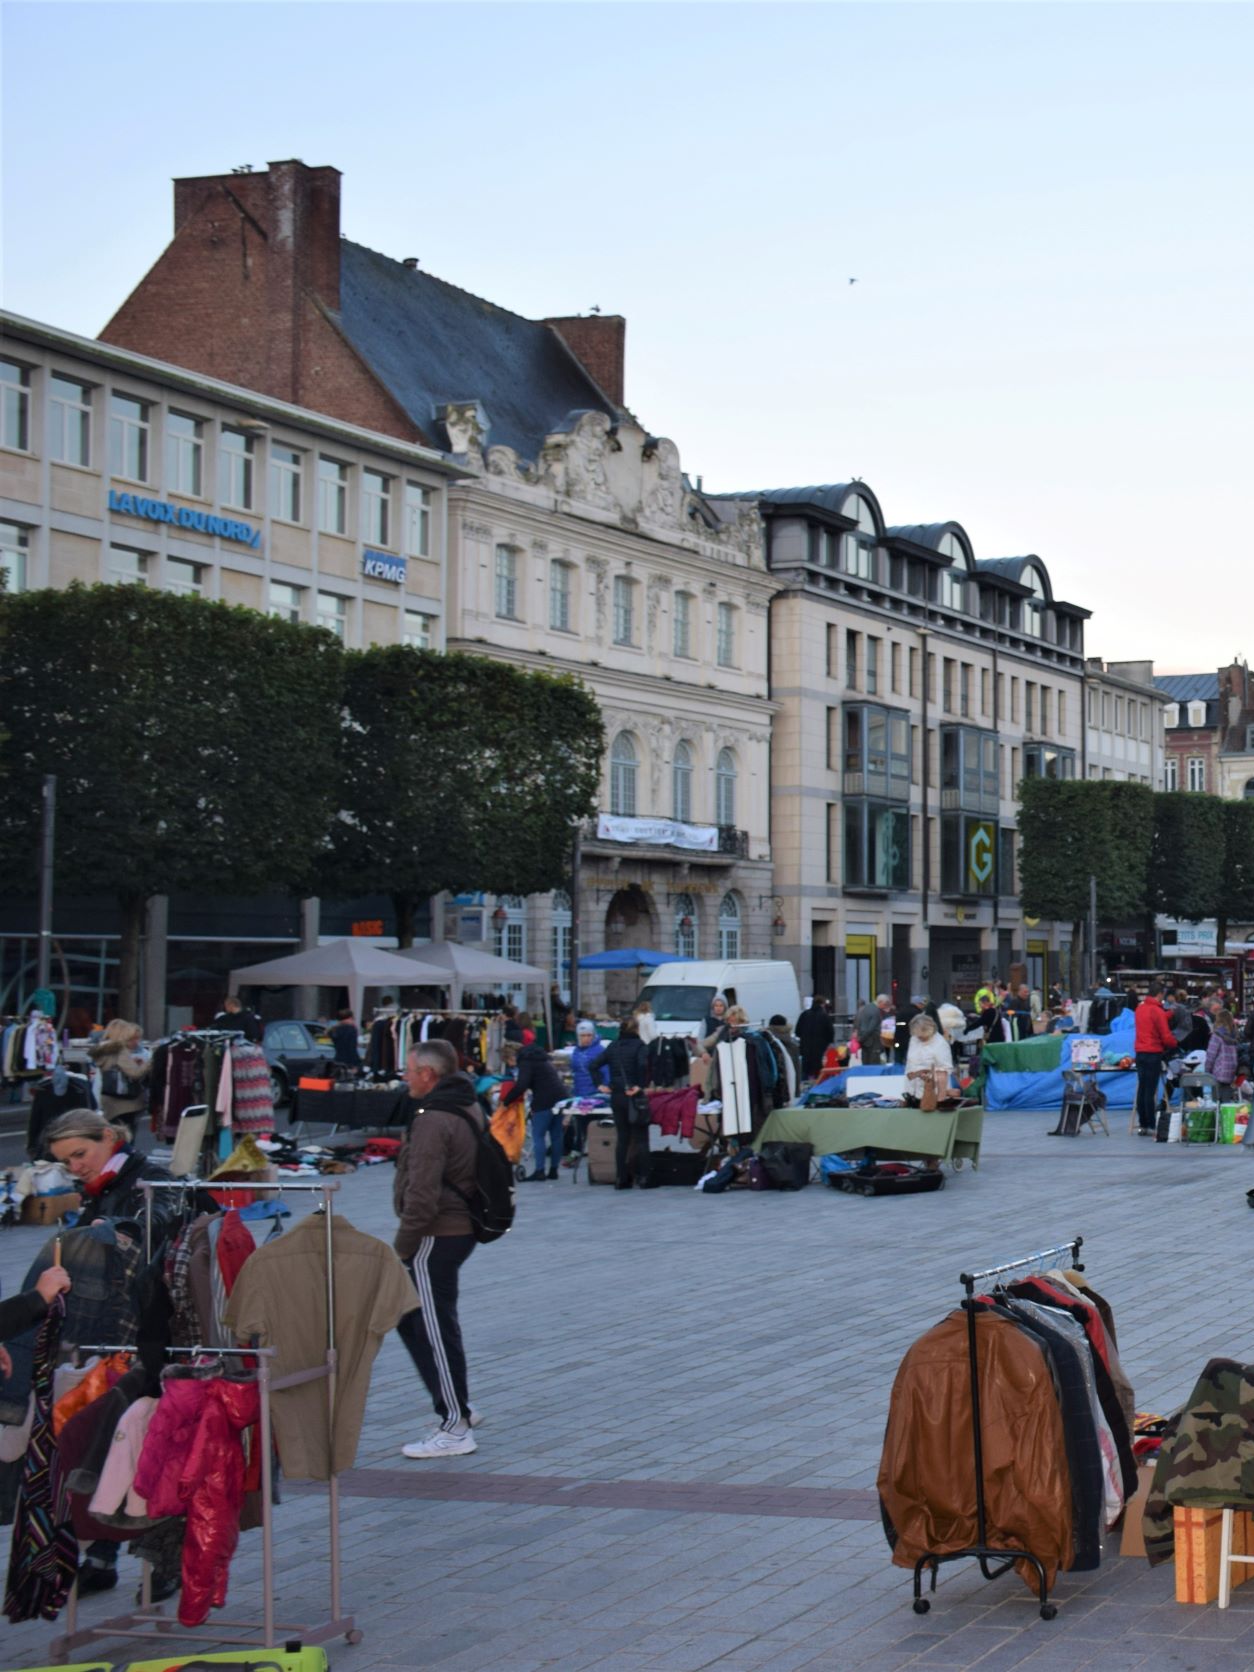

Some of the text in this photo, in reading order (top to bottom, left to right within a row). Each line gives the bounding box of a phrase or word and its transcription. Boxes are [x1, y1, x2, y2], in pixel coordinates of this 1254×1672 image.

[108, 489, 252, 544] LA VOIX DU NORD
[364, 559, 406, 583] KPMG
[971, 826, 992, 881] G
